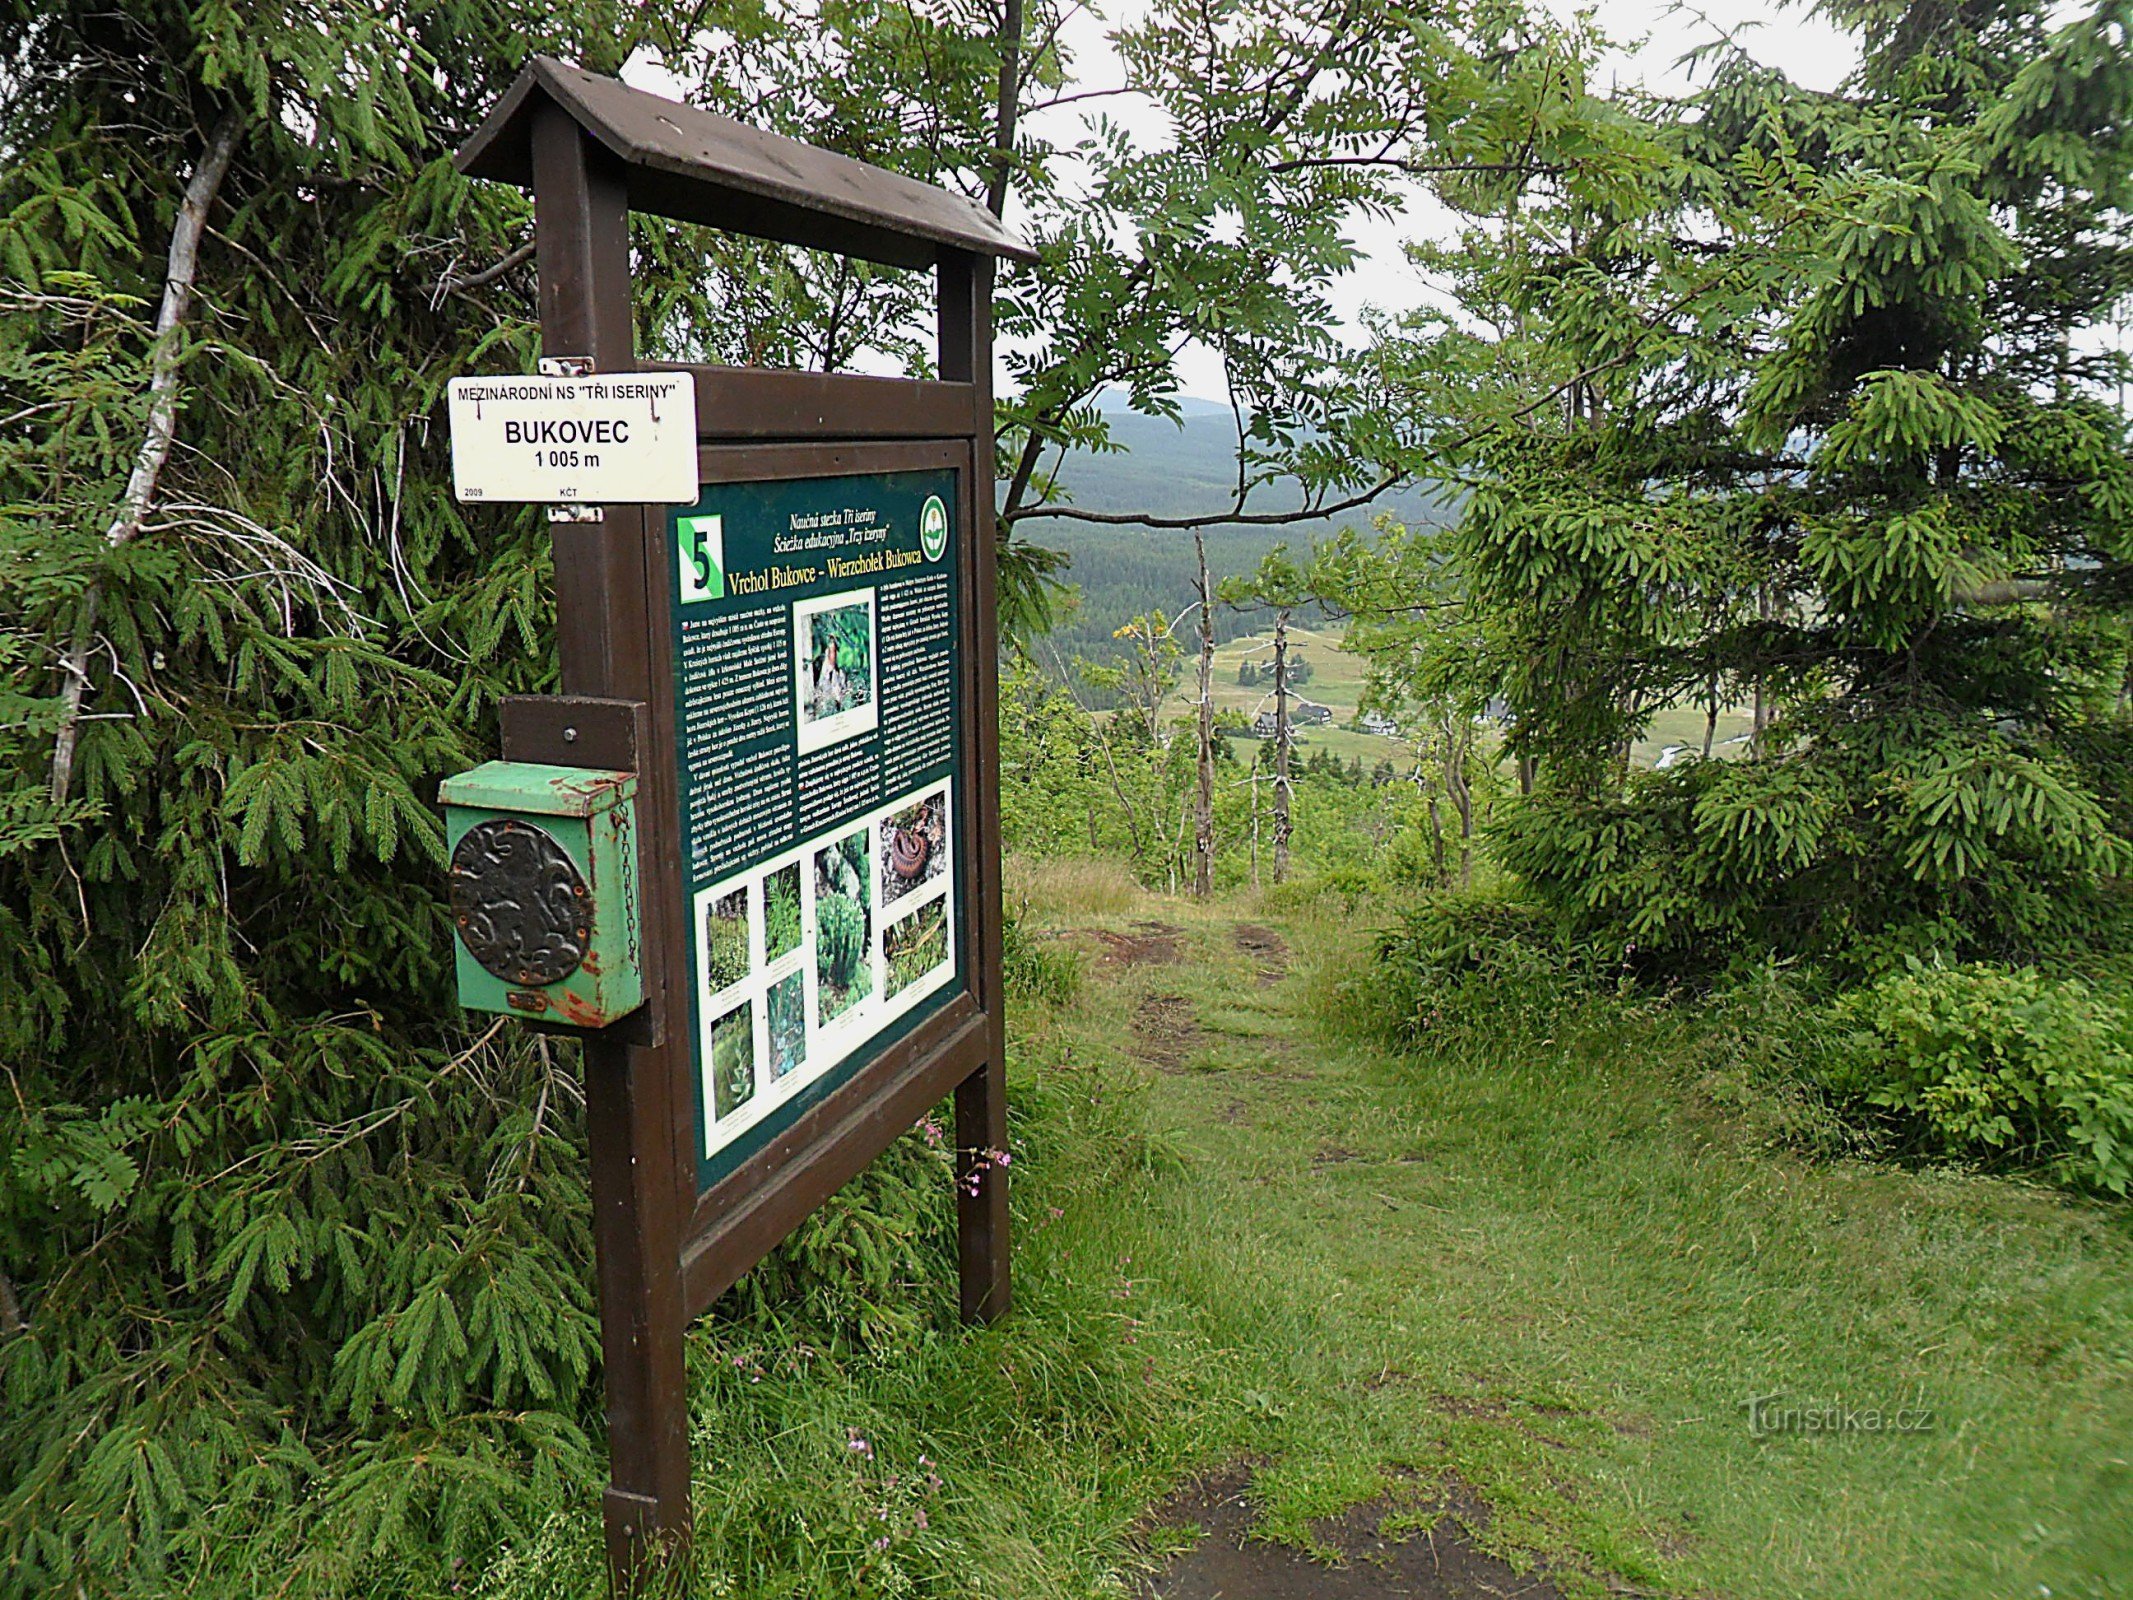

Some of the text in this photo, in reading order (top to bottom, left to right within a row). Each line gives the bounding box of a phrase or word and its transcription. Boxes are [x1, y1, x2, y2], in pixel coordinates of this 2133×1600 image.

[458, 383, 676, 401] MEZINÁRODNÍ NS "TŘI ISERINY"
[505, 420, 630, 444] BUKOVEC
[535, 451, 600, 467] 1 005 m
[464, 488, 483, 497] 2009
[559, 487, 578, 497] KČT
[789, 513, 819, 530] Naučná
[820, 511, 842, 528] stezka
[855, 508, 877, 525] iseriny
[804, 532, 845, 551] edukacyjna
[693, 531, 711, 590] 5
[729, 567, 769, 595] Vrchol
[771, 564, 816, 590] Bukovce
[827, 554, 884, 579] Wierzchołek
[885, 549, 922, 570] Bukowca
